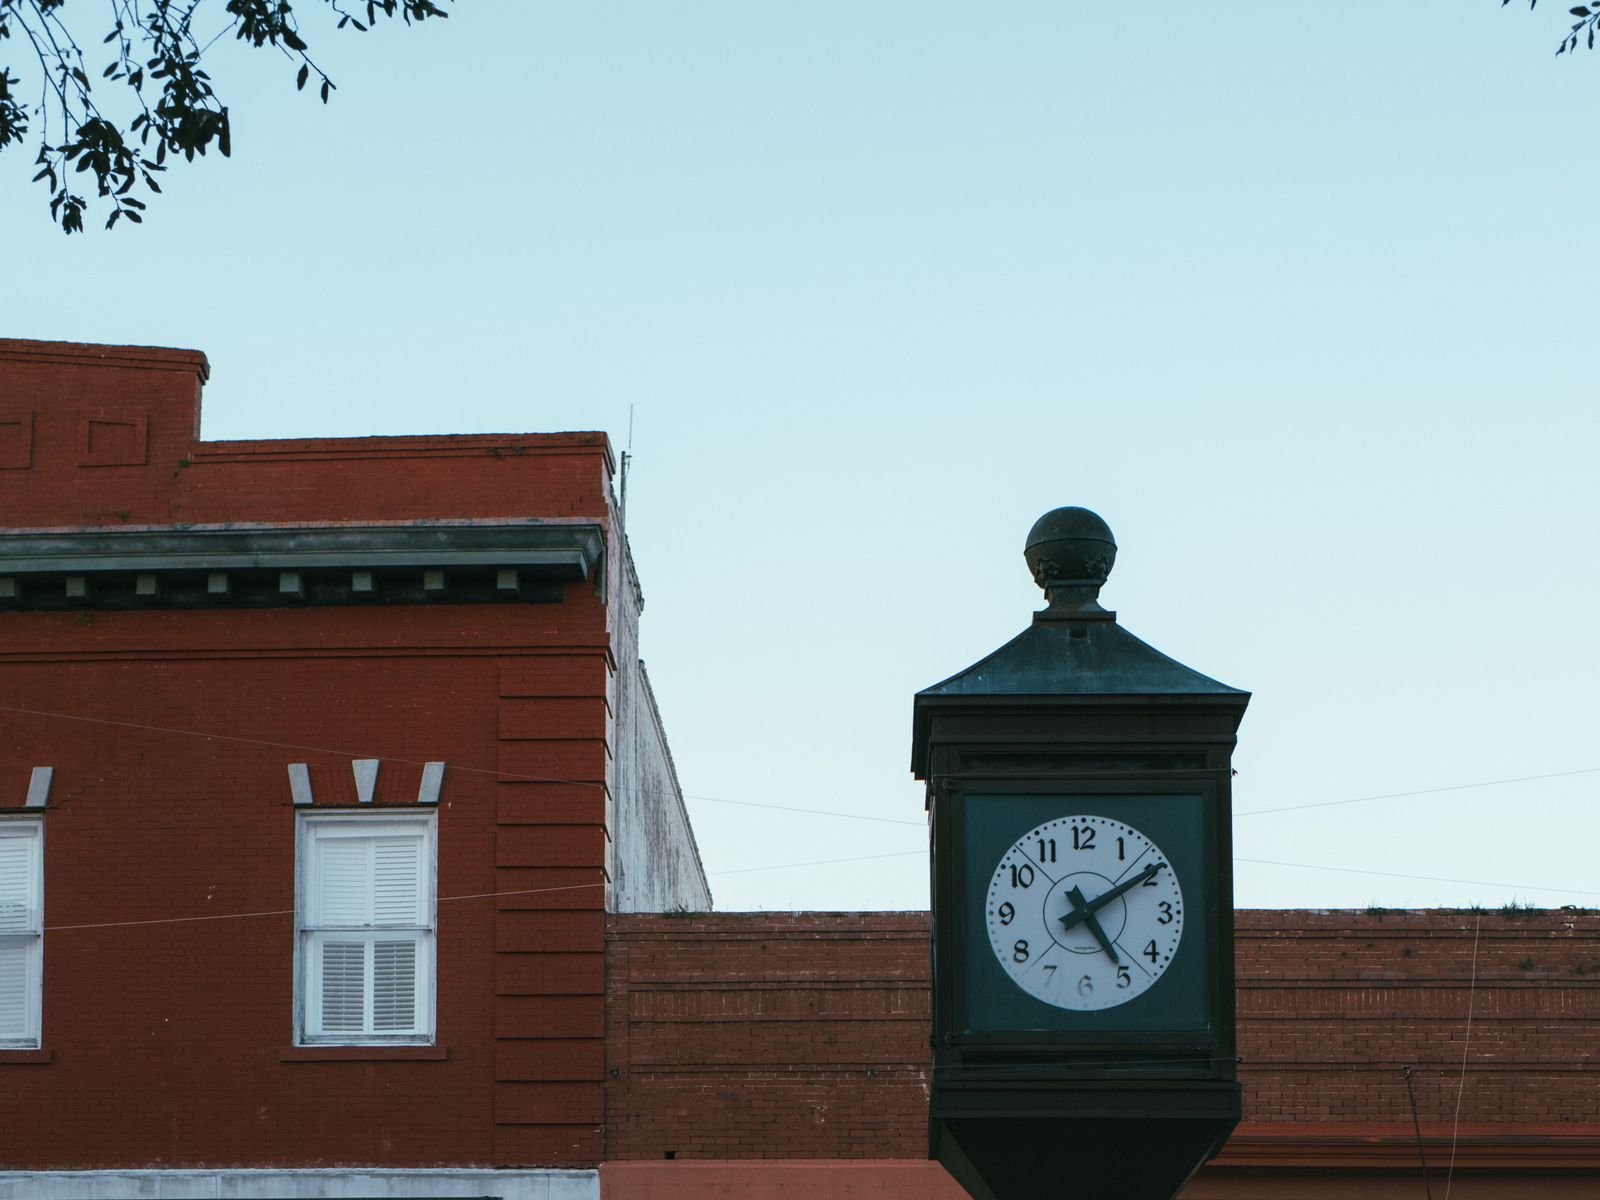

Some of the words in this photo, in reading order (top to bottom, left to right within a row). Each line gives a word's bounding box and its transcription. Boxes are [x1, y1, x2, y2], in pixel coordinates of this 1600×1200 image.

[1037, 838, 1057, 863] 11
[1071, 825, 1096, 851] 12
[1116, 836, 1125, 861] 1
[1009, 863, 1035, 888] 10
[1142, 863, 1160, 887] 2
[998, 901, 1015, 926] 9
[1157, 901, 1173, 925] 3
[1013, 939, 1030, 964] 8
[1143, 939, 1160, 964] 4
[1043, 965, 1058, 989] 7
[1077, 974, 1094, 998] 6
[1116, 965, 1131, 989] 5
